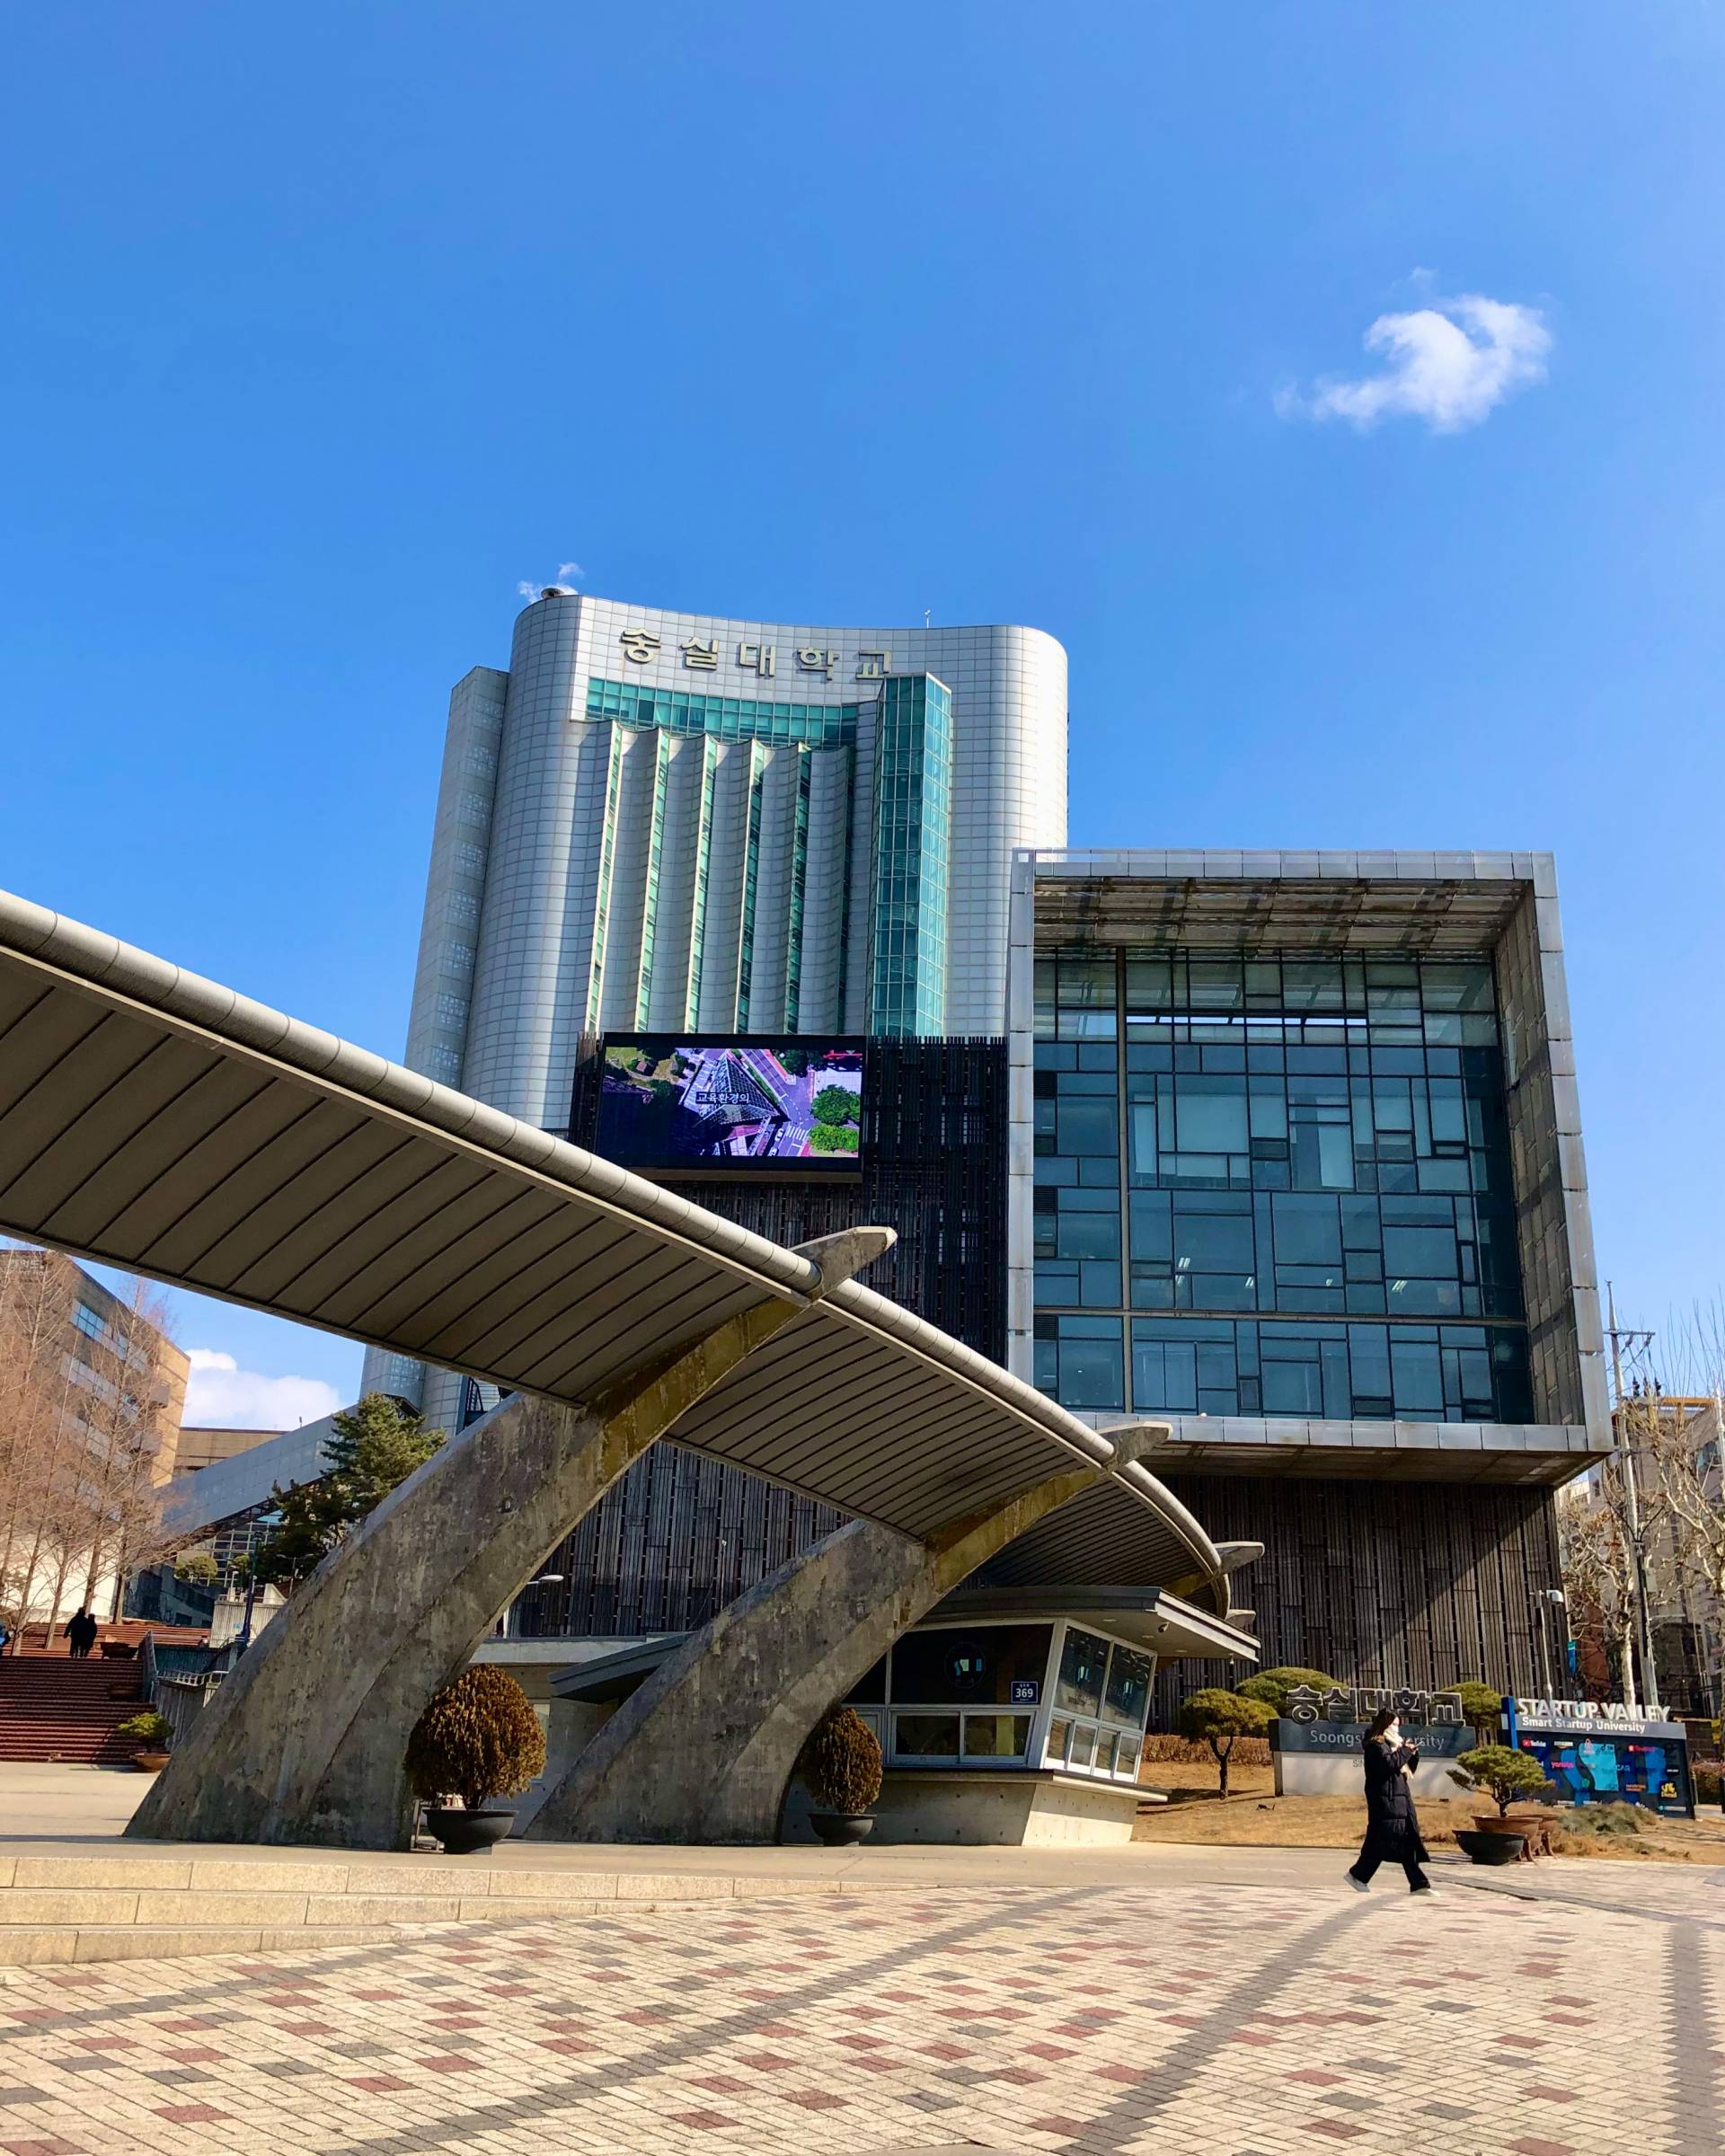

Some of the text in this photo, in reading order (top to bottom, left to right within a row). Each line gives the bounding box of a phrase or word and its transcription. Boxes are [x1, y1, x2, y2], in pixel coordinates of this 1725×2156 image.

[620, 626, 892, 681] 숭실대학교
[696, 1092, 749, 1104] 교육환경의
[1015, 1688, 1033, 1698] 369
[1286, 1684, 1465, 1727] 숭실대학교
[1517, 1698, 1671, 1723] STARTUP VALLEY
[1522, 1717, 1646, 1734] Smart Startup University
